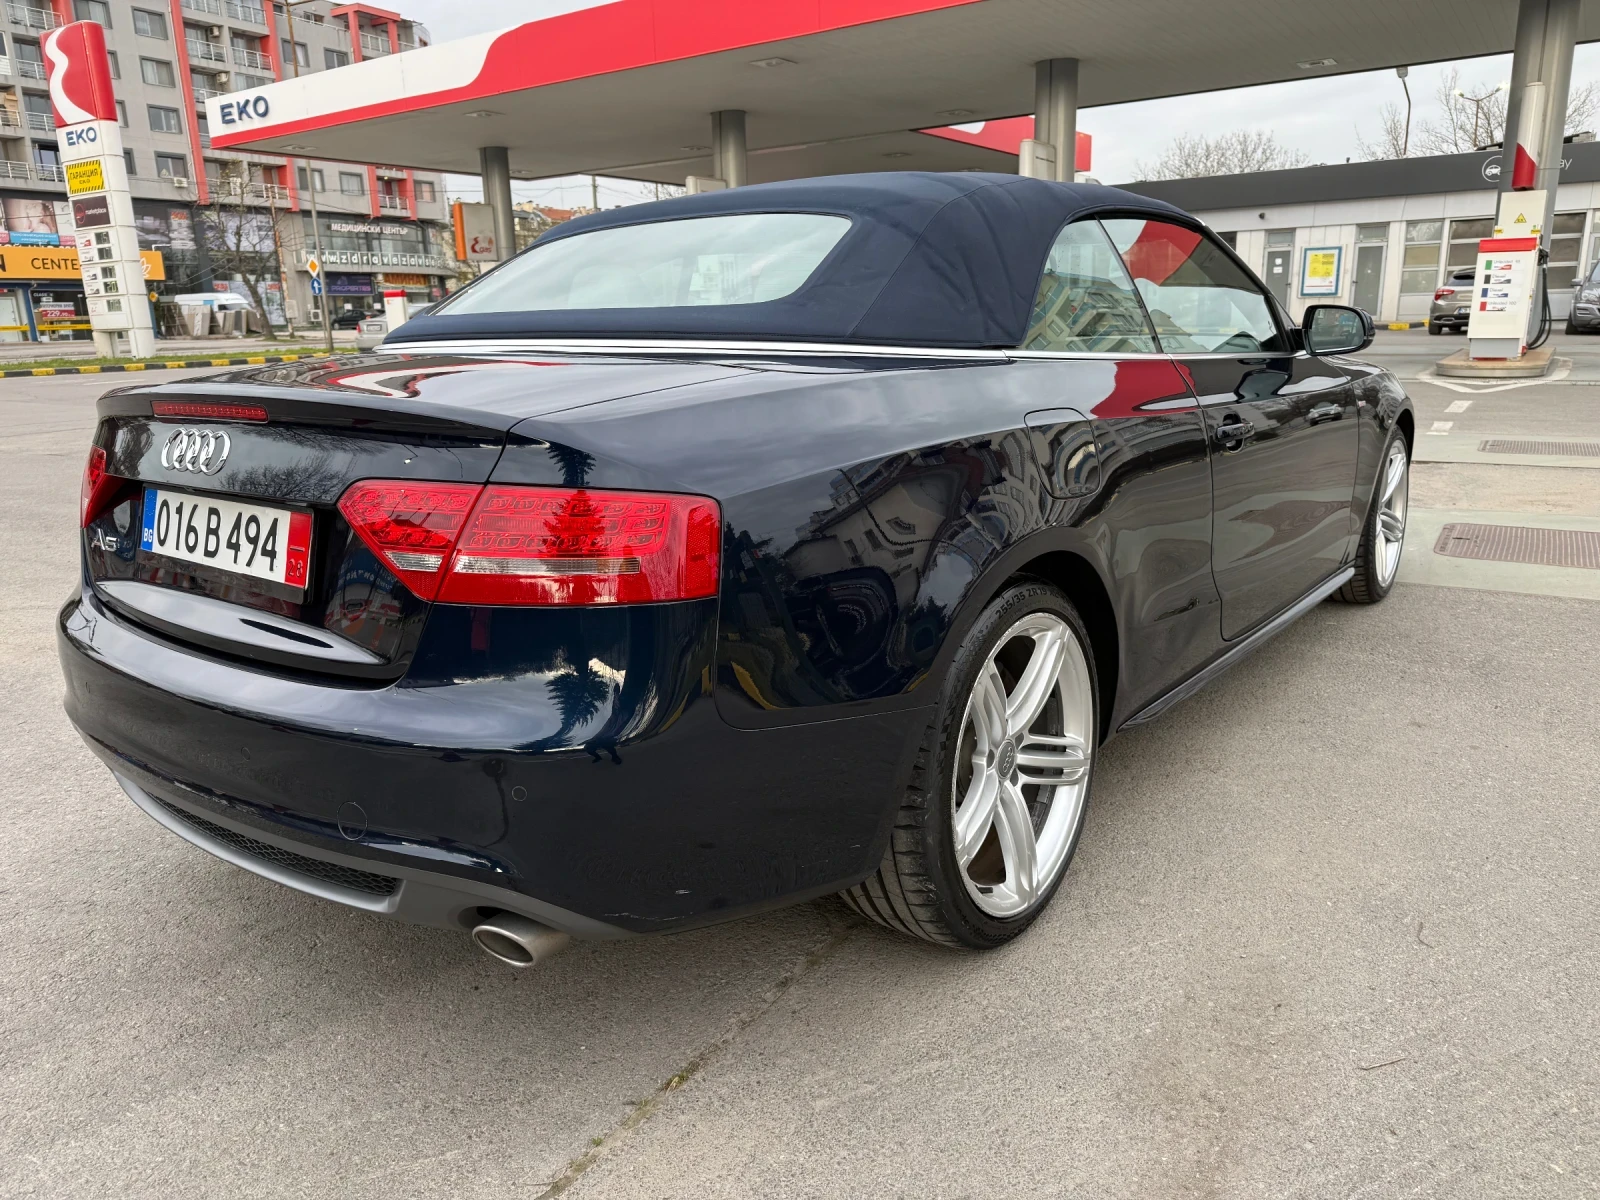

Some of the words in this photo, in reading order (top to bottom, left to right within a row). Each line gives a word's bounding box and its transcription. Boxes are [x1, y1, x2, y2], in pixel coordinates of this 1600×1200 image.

[220, 95, 269, 125] EKO
[66, 126, 97, 147] EKO
[69, 168, 99, 180] ГАРАНЦИЯ
[331, 223, 381, 234] МЕДИЦИНСКИ
[382, 226, 409, 235] ЦЕНТЪР
[30, 257, 81, 271] CENTE
[91, 528, 119, 552] A5
[143, 527, 153, 543] BG
[994, 591, 1026, 619] 255/35
